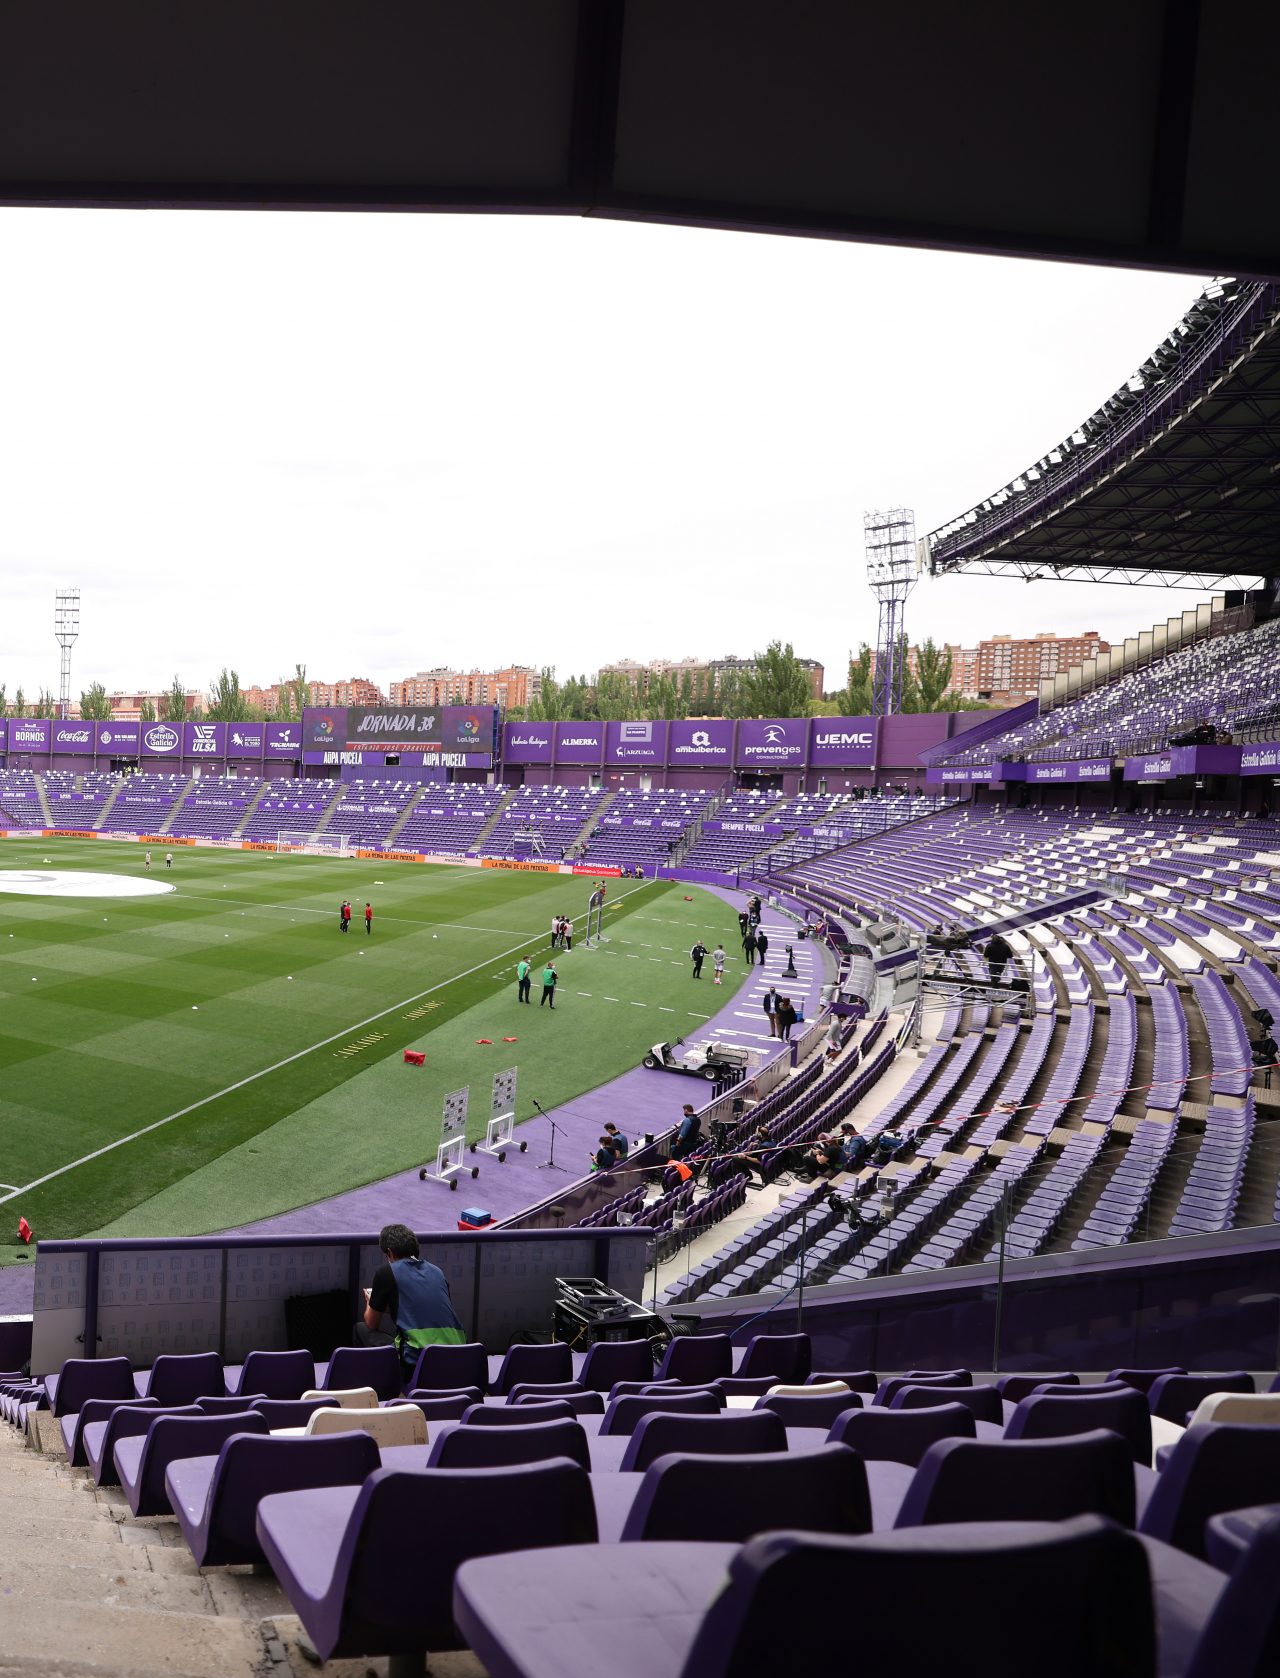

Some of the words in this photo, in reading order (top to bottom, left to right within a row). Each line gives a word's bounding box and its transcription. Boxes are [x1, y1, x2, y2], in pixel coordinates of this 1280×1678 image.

[357, 714, 416, 734] JORNADA
[417, 715, 435, 732] 38
[15, 732, 45, 742] BORNOS
[149, 732, 174, 740] Estrella
[816, 733, 873, 744] UEMC
[150, 739, 173, 747] Galicia
[192, 743, 216, 752] ULSA
[745, 746, 801, 756] prevenges
[340, 752, 362, 765] PUCELA
[441, 753, 466, 767] PUCELA
[1241, 753, 1259, 768] Estrella
[1260, 750, 1277, 767] Galicia
[1144, 763, 1159, 774] Estrella
[722, 823, 744, 831] SIEMPRE
[745, 824, 765, 832] PUCELA
